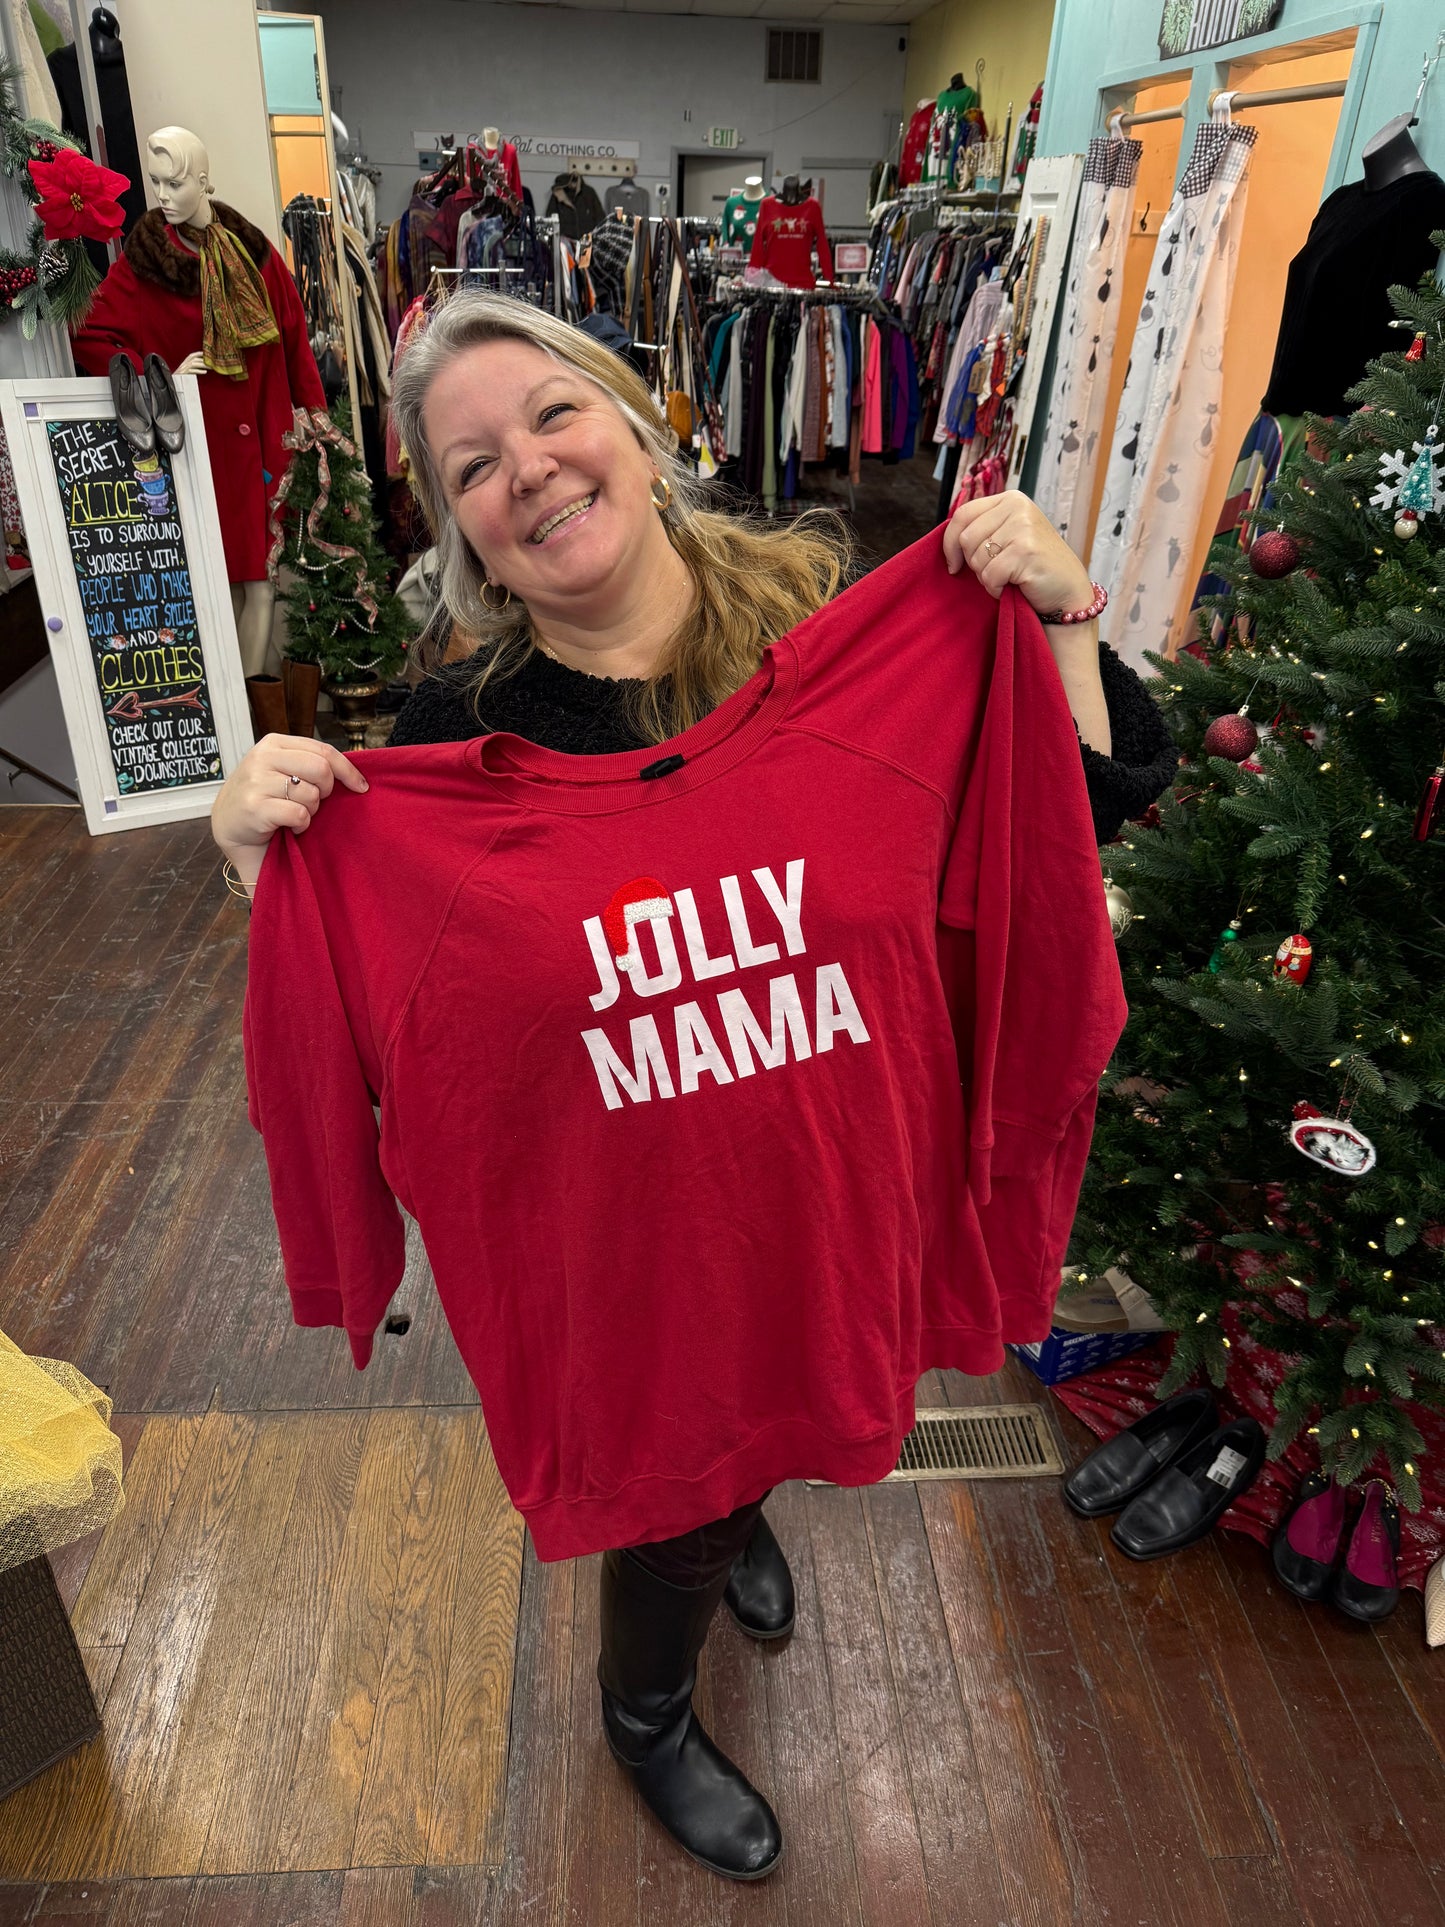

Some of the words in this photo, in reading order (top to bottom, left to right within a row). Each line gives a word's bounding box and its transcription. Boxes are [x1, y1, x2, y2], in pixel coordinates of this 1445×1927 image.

[536, 142, 595, 157] CLOTHING
[597, 145, 618, 158] CO.
[713, 128, 735, 147] EXIT
[54, 422, 96, 452] THE
[58, 439, 126, 483] SECRET,
[70, 480, 147, 524] ALICE,
[69, 530, 91, 549] IS
[95, 527, 114, 545] TO
[119, 522, 182, 546] SURROUND
[86, 551, 143, 576] YOURSELF
[147, 548, 180, 569] WITH
[80, 575, 126, 607] PEOPLE
[131, 573, 158, 601] WHO
[161, 570, 192, 599] MAKE
[86, 611, 119, 637] YOUR
[122, 604, 159, 631] HEART
[130, 630, 158, 648] AND
[101, 646, 204, 690] CLOTHES
[112, 722, 149, 746] CHECK
[152, 720, 174, 740] OUT
[178, 718, 204, 736] OUR
[113, 743, 161, 767] VINTAGE
[162, 736, 219, 758] COLLECTION
[134, 757, 209, 783] DOWNSTAIRS
[582, 858, 807, 1012] JOLLY
[580, 962, 871, 1110] MAMA
